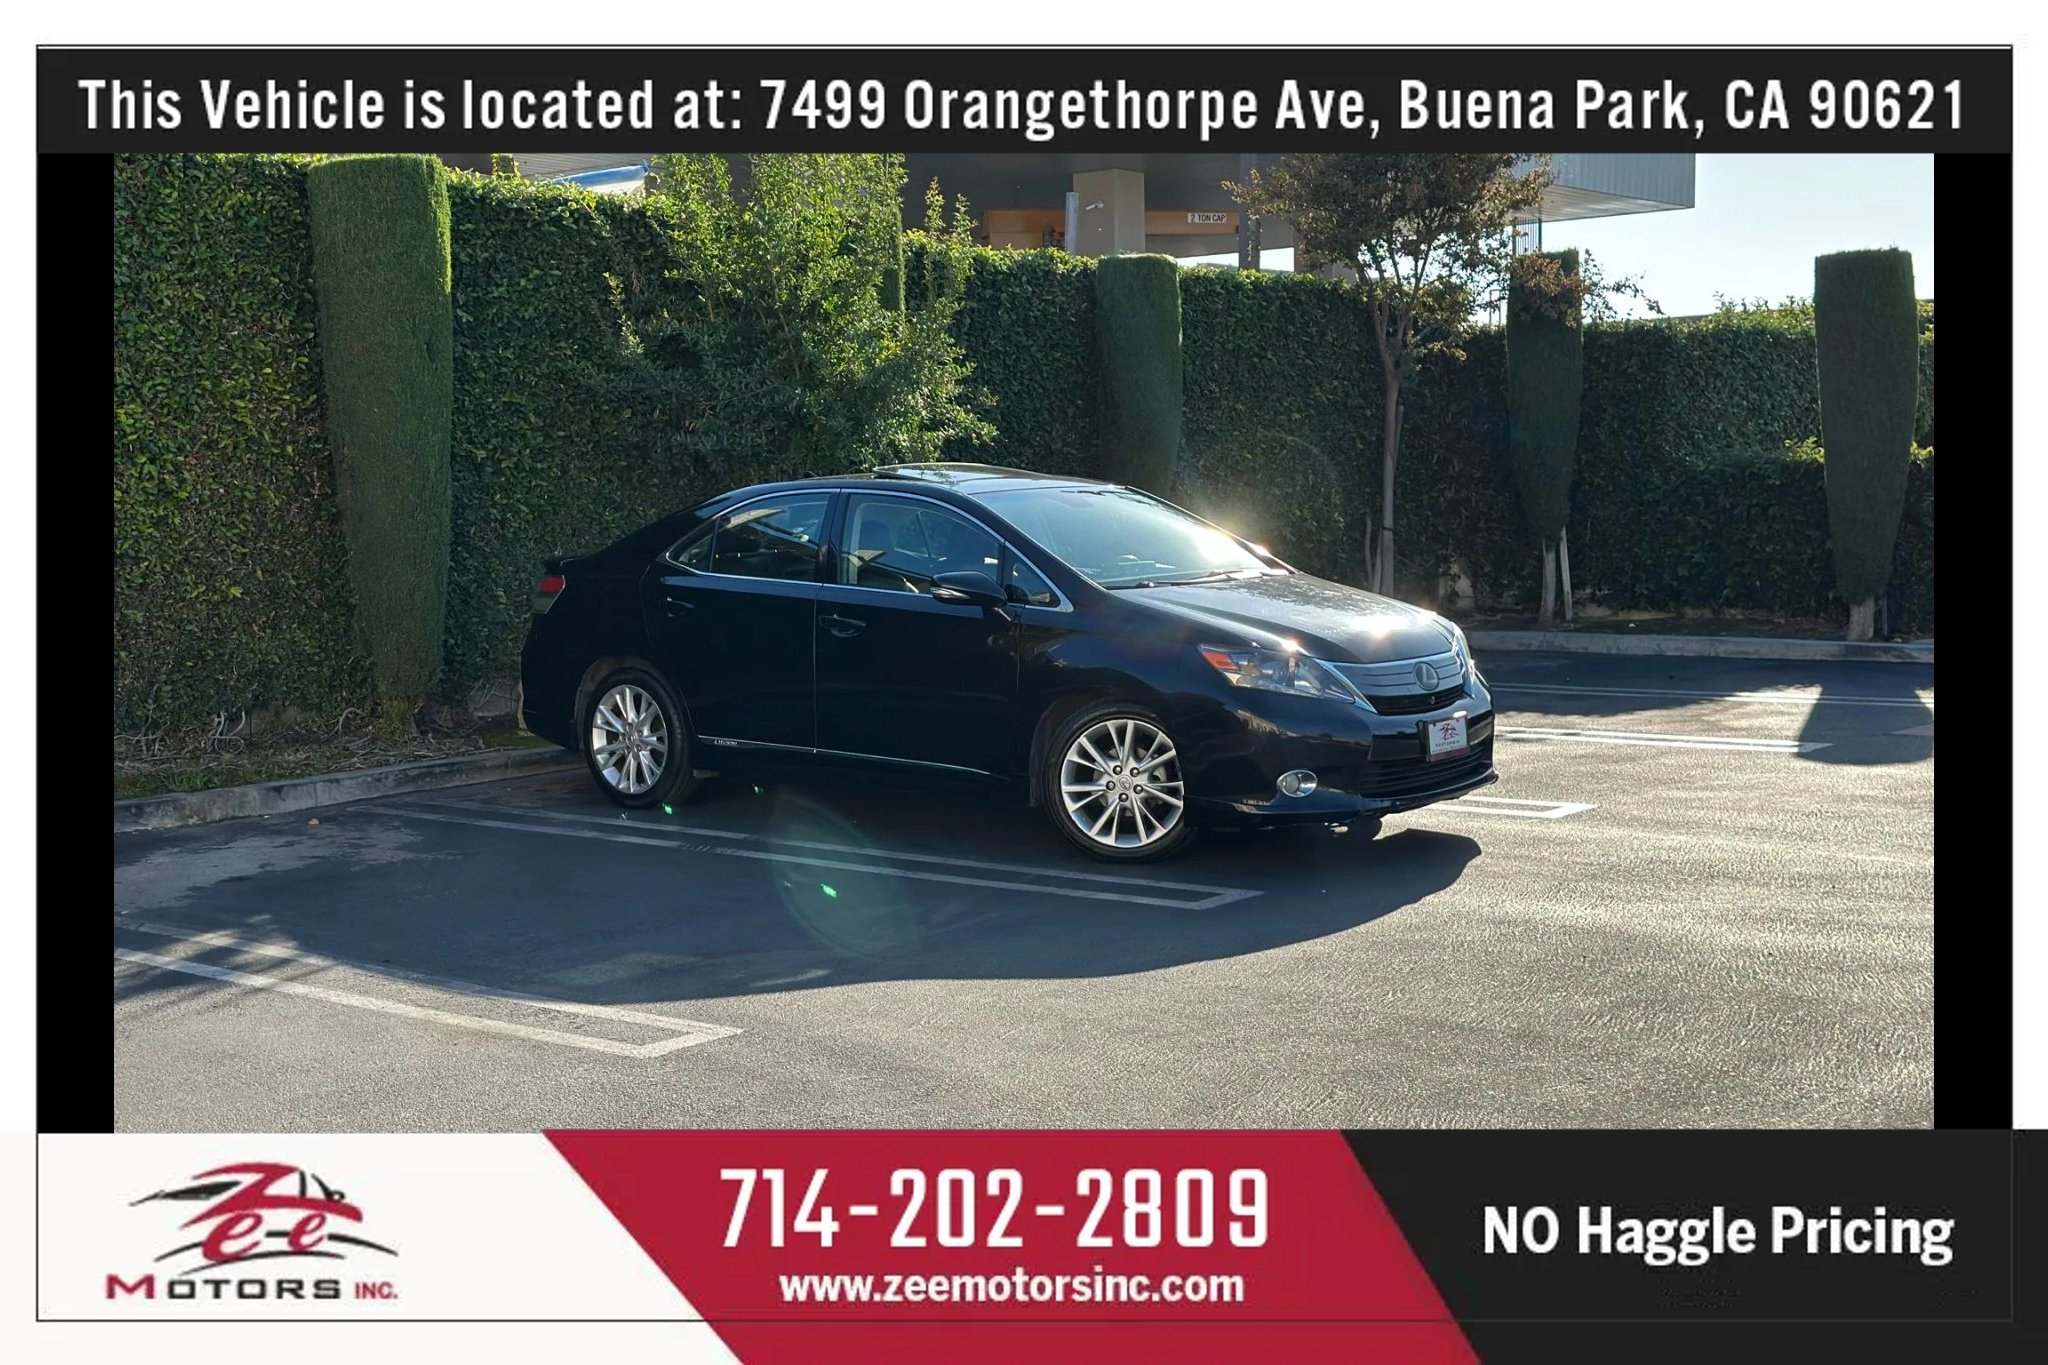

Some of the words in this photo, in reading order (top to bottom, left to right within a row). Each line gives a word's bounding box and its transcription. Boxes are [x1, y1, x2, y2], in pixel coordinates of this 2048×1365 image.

[1190, 214, 1197, 222] 2
[1198, 214, 1211, 222] TON
[1212, 214, 1226, 222] CAP
